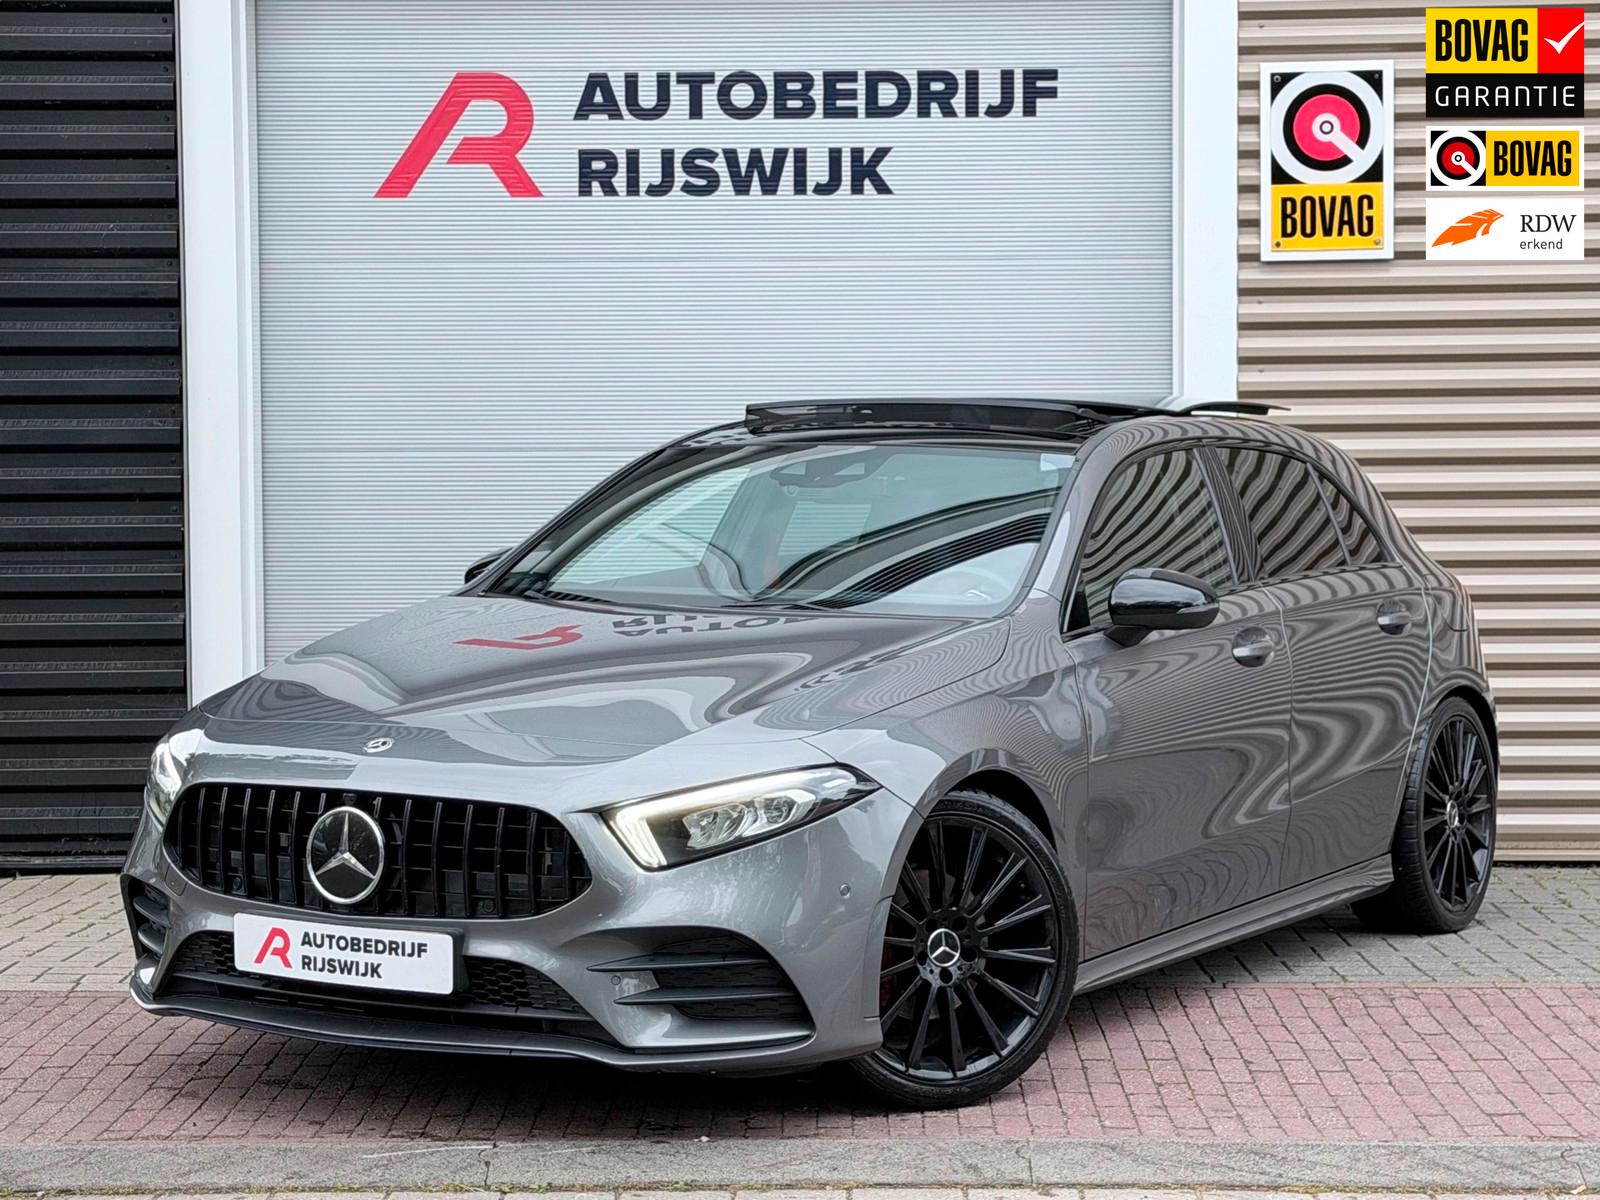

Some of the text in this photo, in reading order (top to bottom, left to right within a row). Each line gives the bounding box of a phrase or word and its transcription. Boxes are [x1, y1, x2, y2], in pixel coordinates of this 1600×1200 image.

[574, 69, 1059, 121] AUTOBEDRIJF
[578, 147, 894, 197] RIJSWIJK
[1280, 194, 1374, 238] BOVAG
[301, 931, 428, 958] AUTOBEDRIJF
[301, 955, 382, 979] RIJSWIJK
